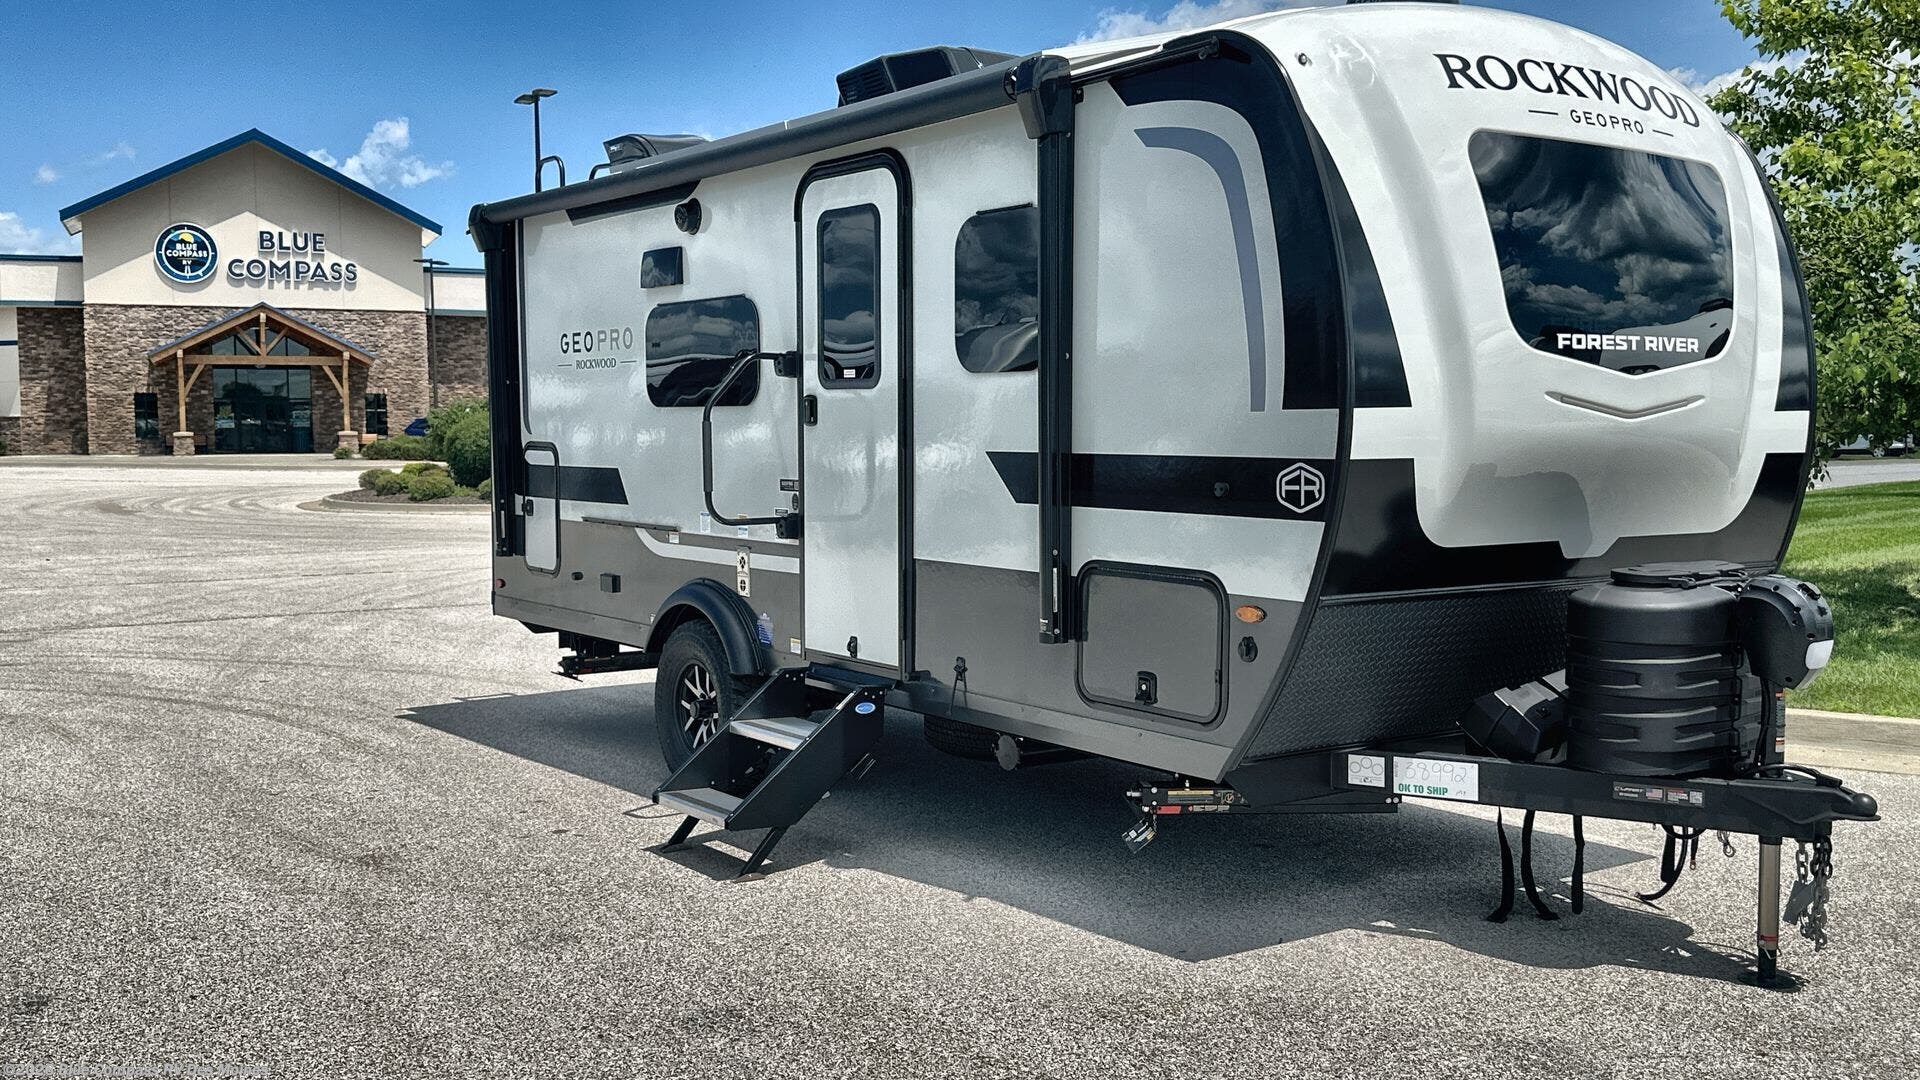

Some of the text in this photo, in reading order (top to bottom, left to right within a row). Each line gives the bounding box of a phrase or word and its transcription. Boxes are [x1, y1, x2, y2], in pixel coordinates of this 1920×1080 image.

[1432, 53, 1700, 128] ROCKWOOD
[1569, 109, 1645, 135] GEOPRO
[175, 243, 198, 251] BLUE
[258, 230, 325, 253] BLUE
[166, 249, 208, 258] COMPASS
[227, 258, 358, 281] COMPASS
[560, 327, 633, 354] GEOPRO
[1556, 333, 1699, 353] FOREST RIVER
[575, 357, 617, 370] ROCKWOOD
[1398, 783, 1411, 793] OK
[1413, 784, 1425, 794] TO
[1427, 787, 1448, 796] SHIP
